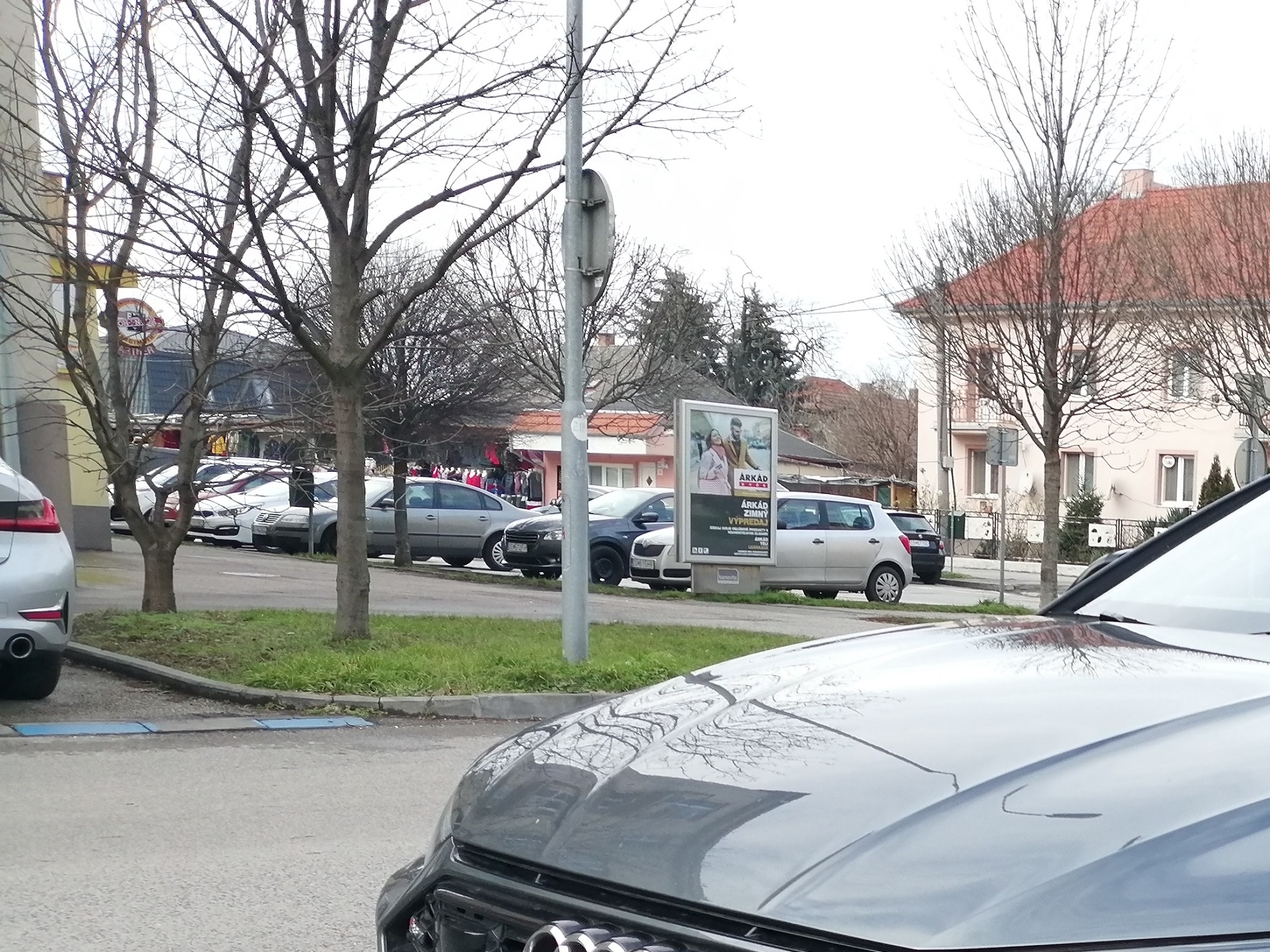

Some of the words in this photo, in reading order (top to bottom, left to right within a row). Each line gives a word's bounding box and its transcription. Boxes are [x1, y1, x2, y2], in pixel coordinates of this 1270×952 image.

[741, 499, 769, 509] ÁRKÁD
[743, 509, 769, 518] ZIMNÝ
[728, 516, 769, 526] VÝPREDAJ
